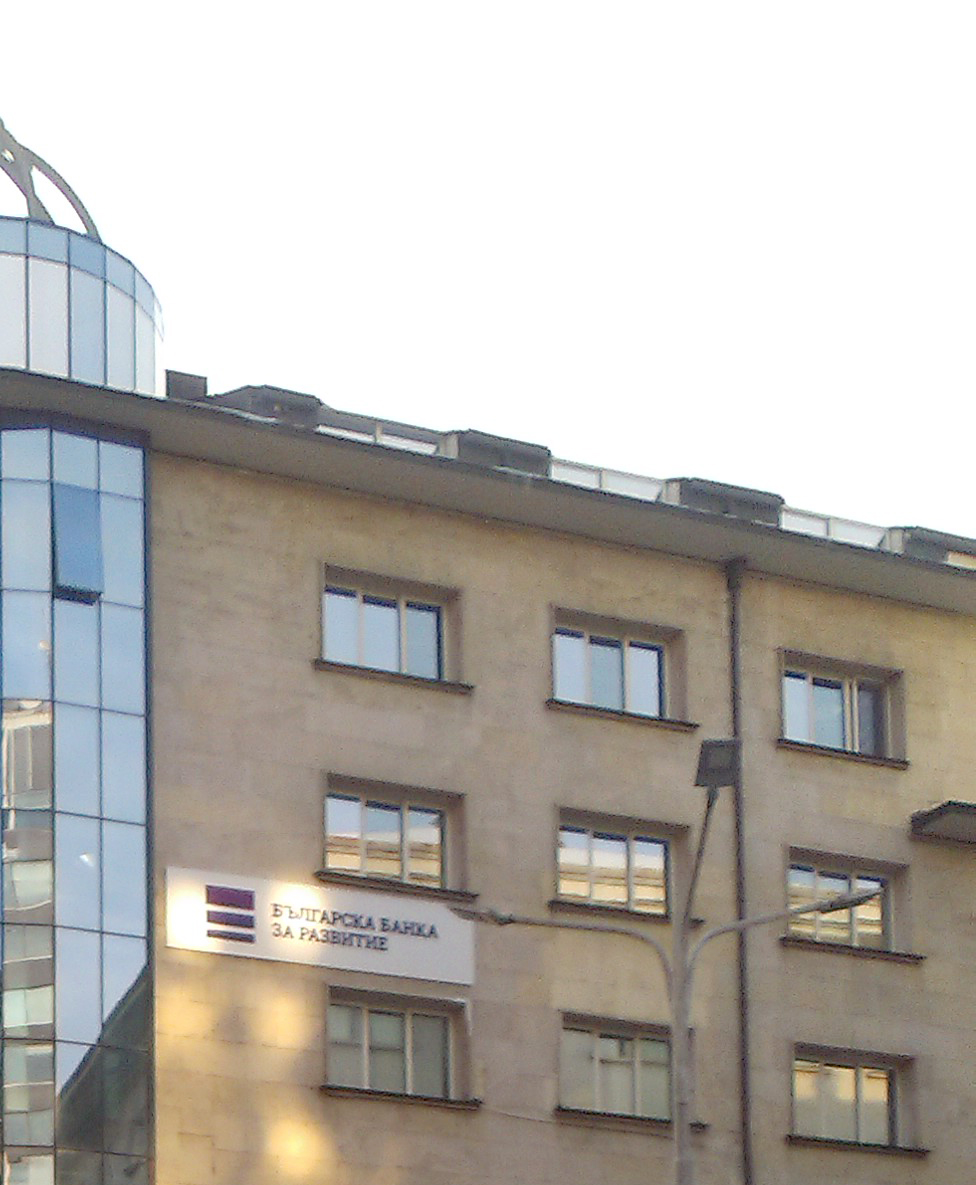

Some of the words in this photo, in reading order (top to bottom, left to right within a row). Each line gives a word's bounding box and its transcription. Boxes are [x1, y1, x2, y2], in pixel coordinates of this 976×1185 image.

[272, 904, 376, 930] БЪЛГАРСКА
[380, 917, 439, 938] БАНКА
[272, 923, 294, 940] ЗА
[300, 927, 388, 951] РАЗВИТИЕ
